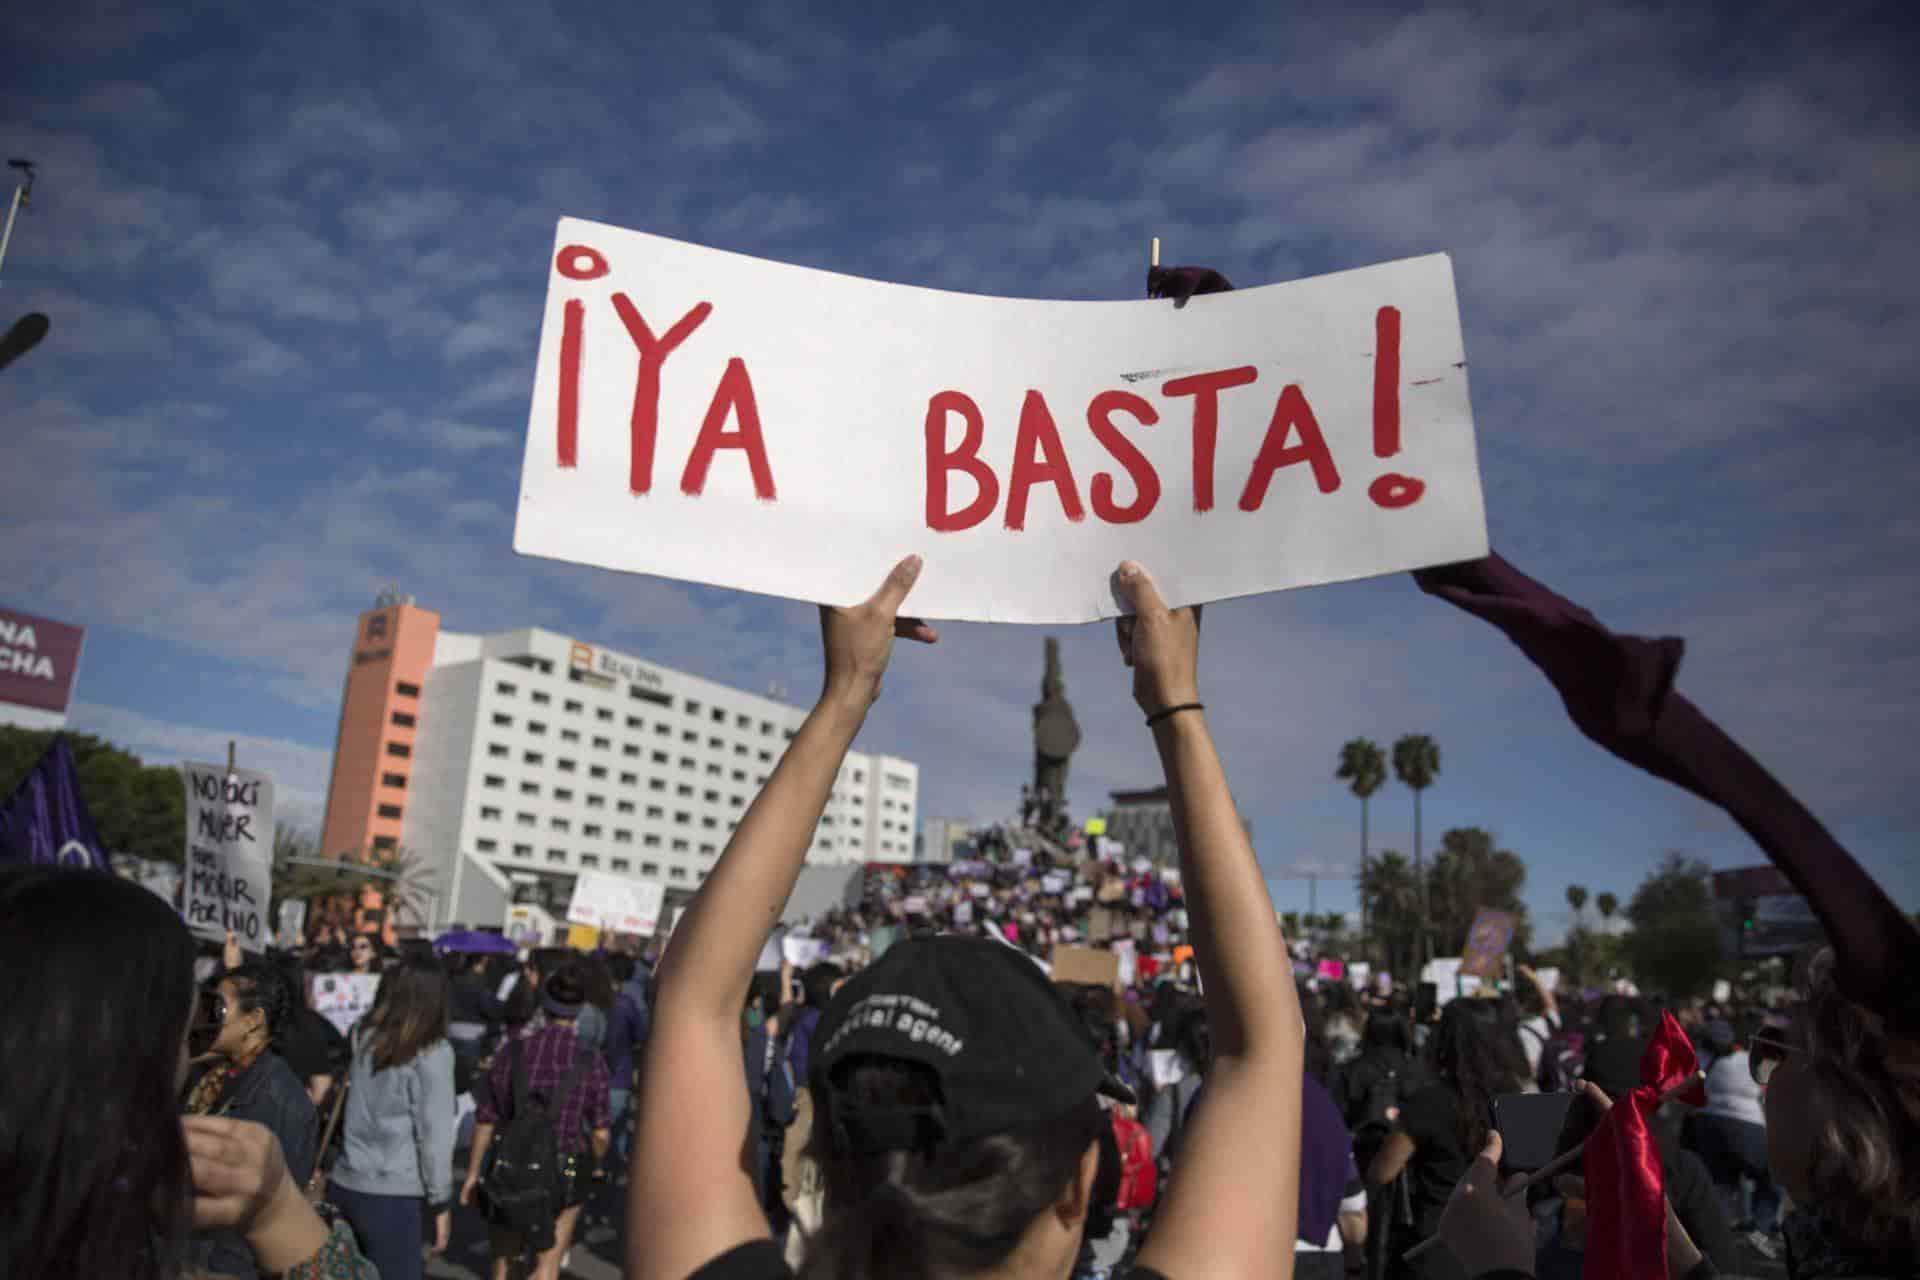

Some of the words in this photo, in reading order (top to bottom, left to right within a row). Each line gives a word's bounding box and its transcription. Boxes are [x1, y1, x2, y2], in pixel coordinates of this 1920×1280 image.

[556, 245, 777, 500] ¡YA
[924, 305, 1425, 532] BASTA!
[896, 1012, 964, 1056] agent
